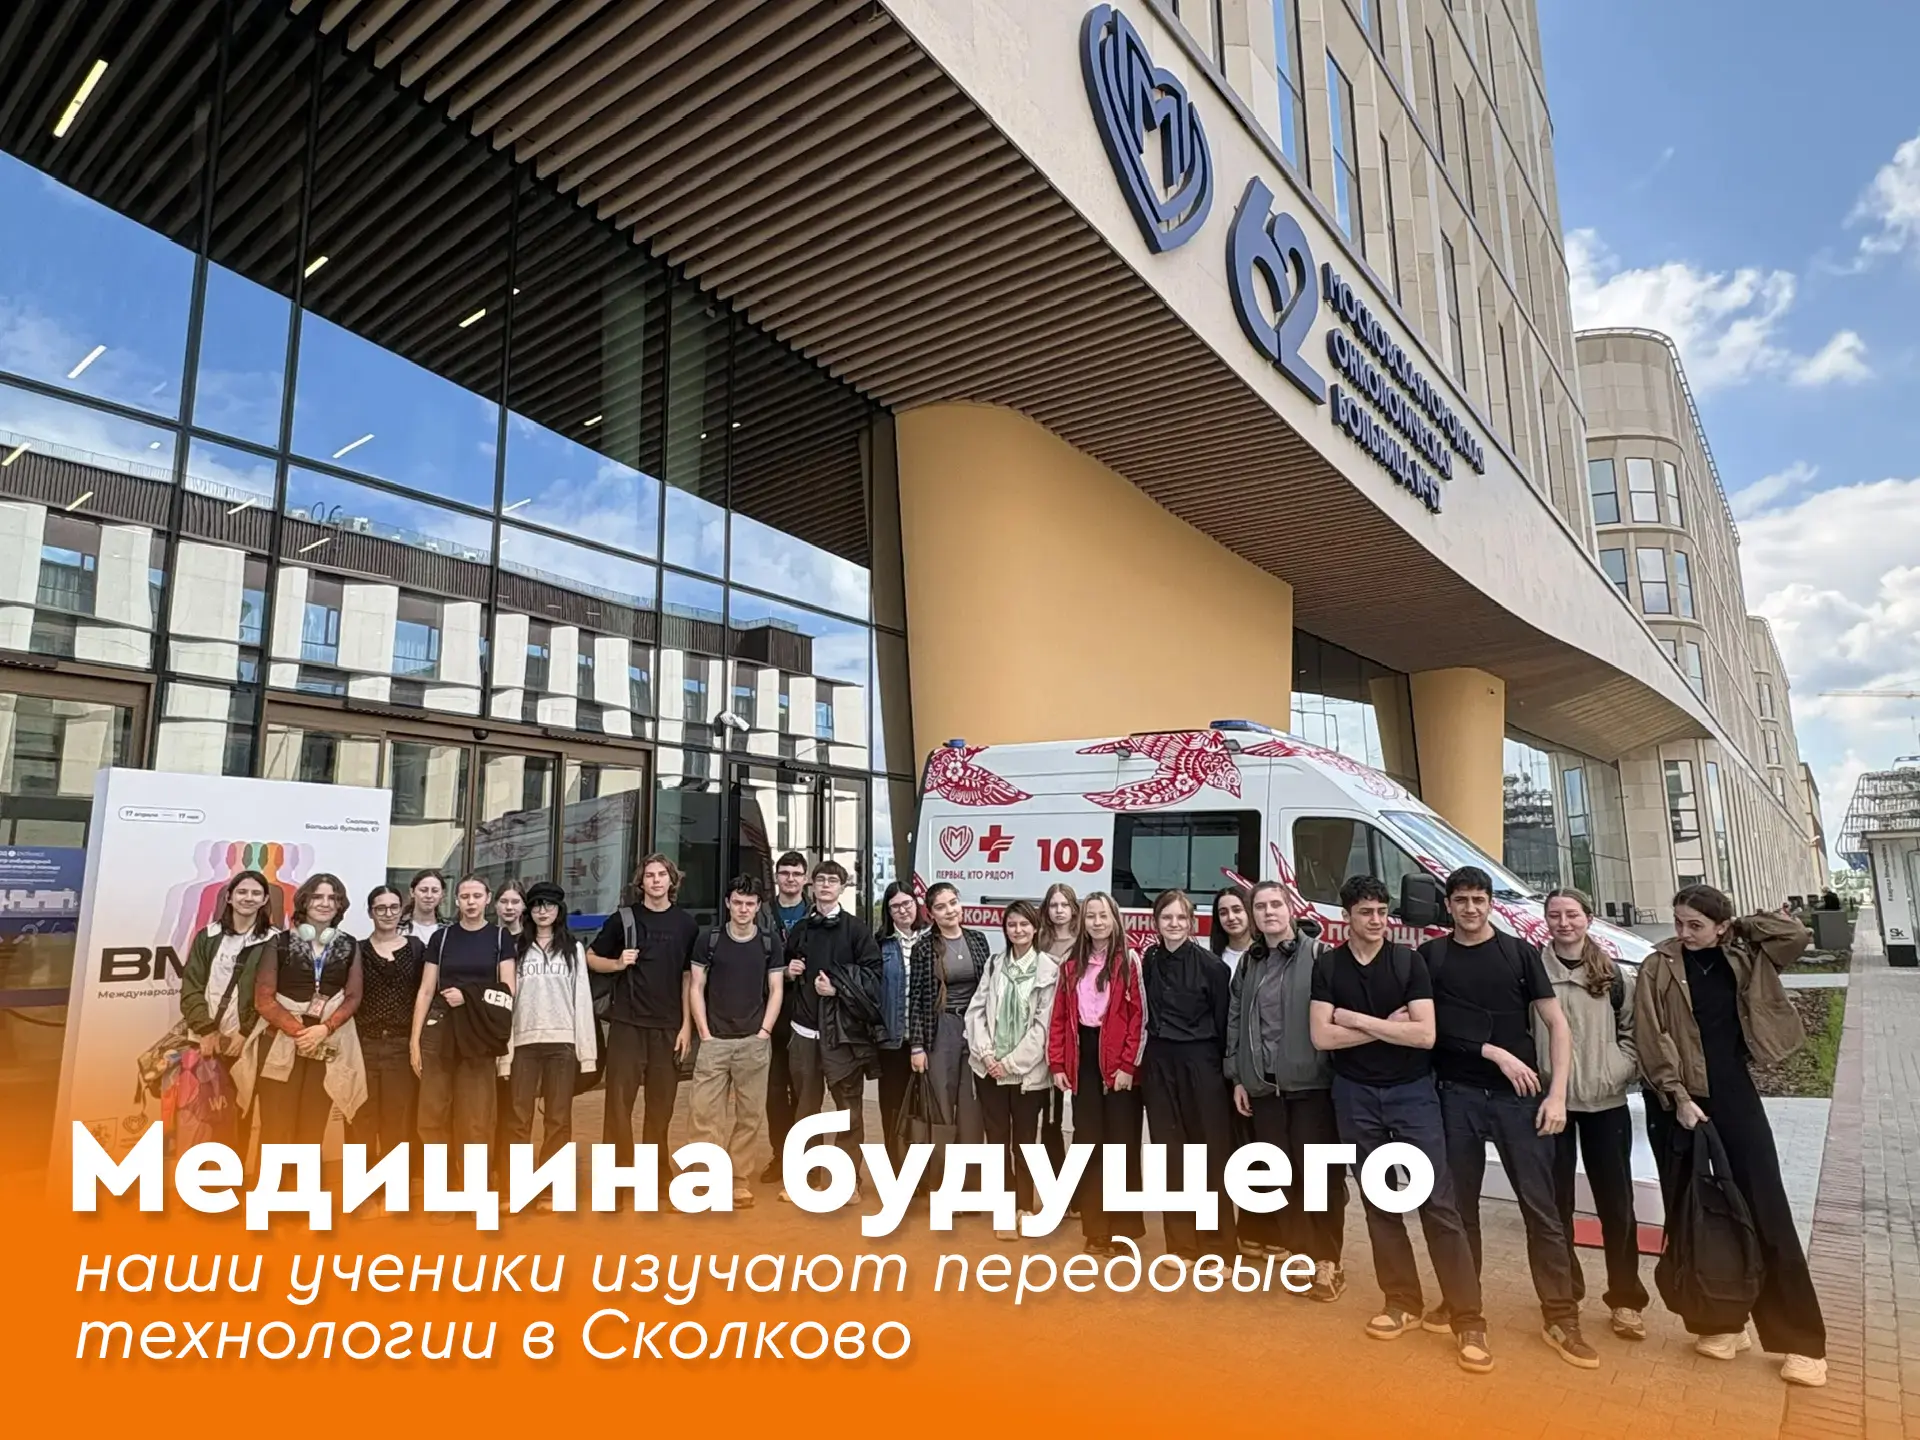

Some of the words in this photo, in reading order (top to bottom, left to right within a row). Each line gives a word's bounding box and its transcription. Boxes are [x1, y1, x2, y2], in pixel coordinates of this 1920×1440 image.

[1322, 262, 1424, 405] МОСКОВСКАЯ
[1326, 328, 1453, 481] ОНКОЛОГИЧЕСКАЯ
[1330, 384, 1416, 494] БОЛЬНИЦА
[1037, 838, 1104, 873] 103
[936, 870, 965, 880] ПЕРВЫЕ,
[967, 870, 983, 880] КТО
[985, 870, 1014, 881] РЯДОМ
[962, 908, 1005, 925] КОРА
[1890, 927, 1905, 937] Sk
